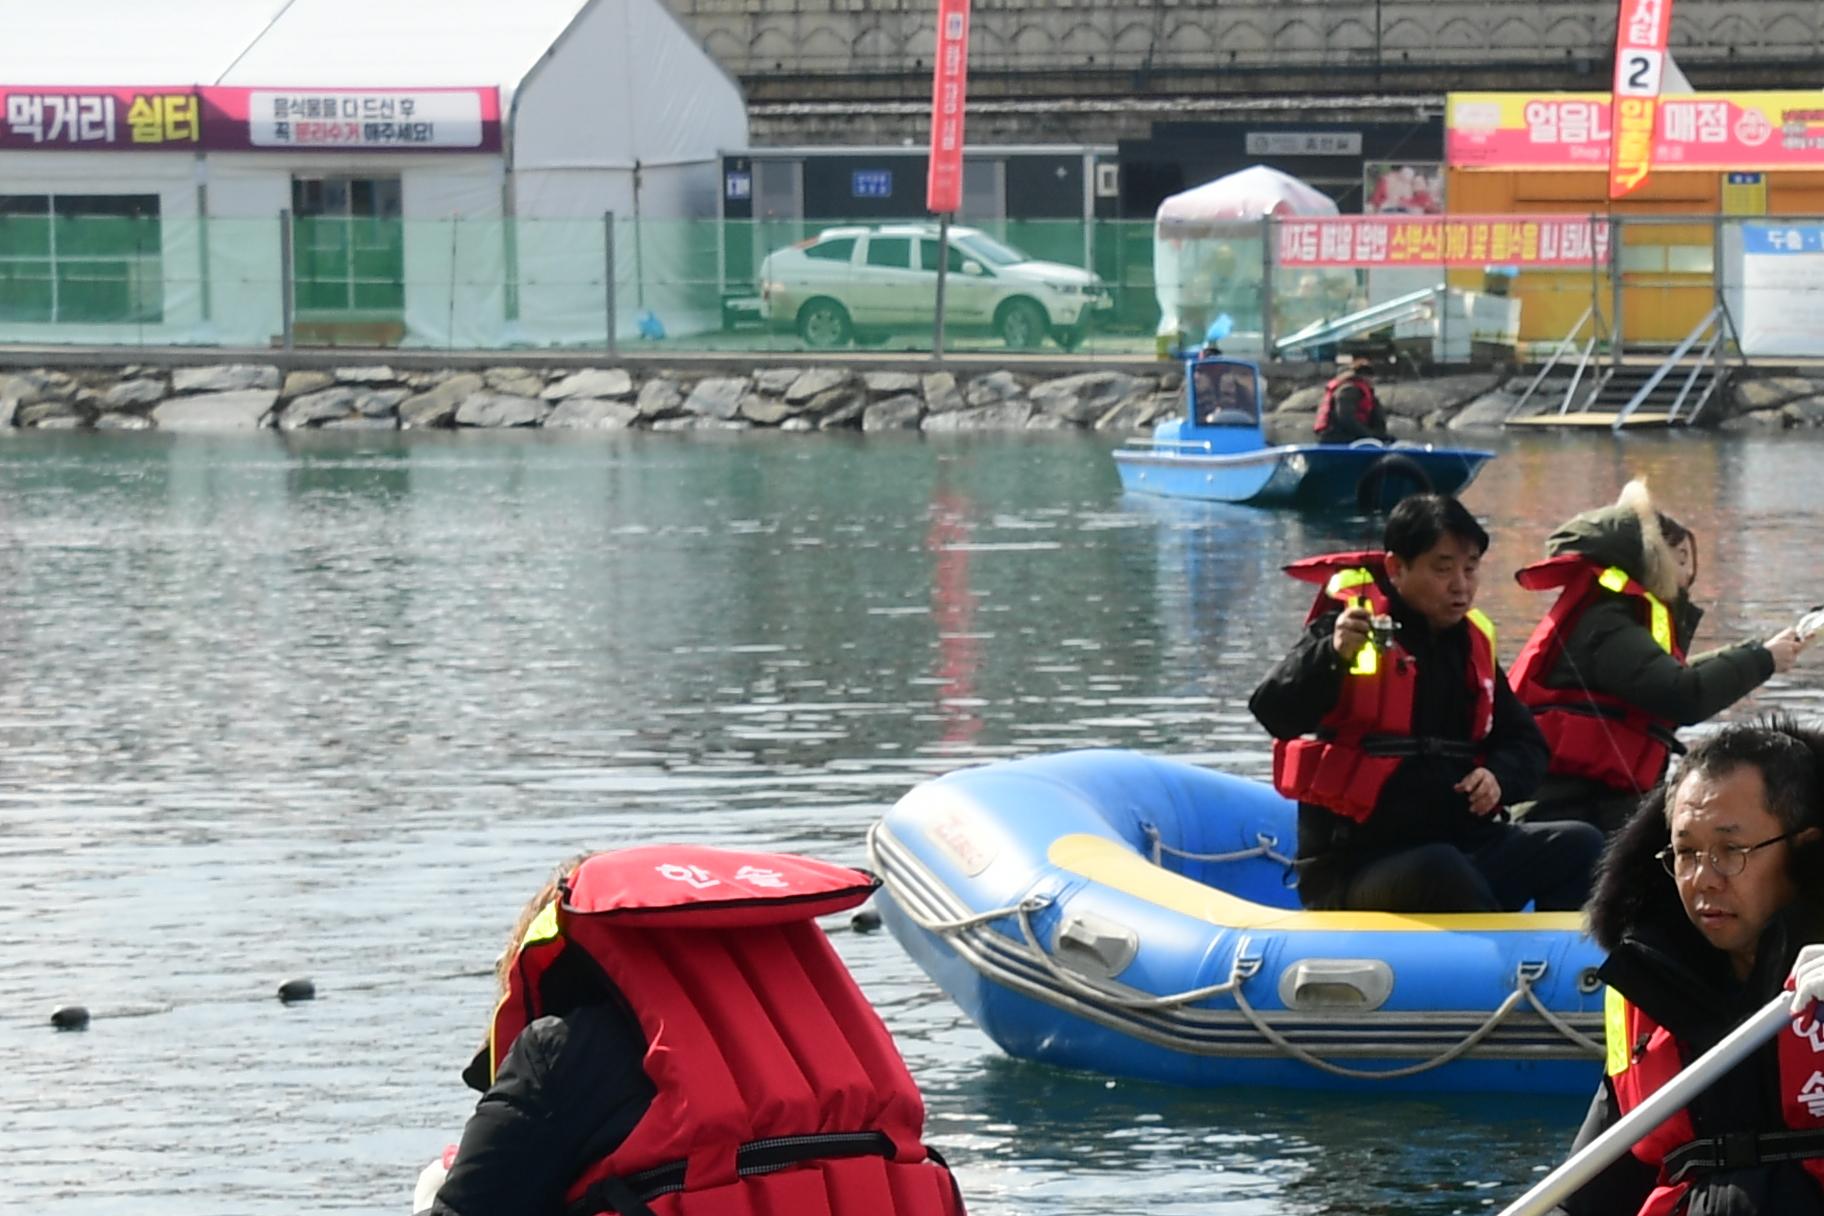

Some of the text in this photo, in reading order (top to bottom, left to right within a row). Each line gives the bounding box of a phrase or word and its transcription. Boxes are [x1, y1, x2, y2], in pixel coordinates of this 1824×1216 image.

[1627, 57, 1650, 88] 2
[7, 95, 199, 143] 먹거리 쉼터
[343, 97, 358, 118] 다
[1664, 101, 1728, 144] 매점
